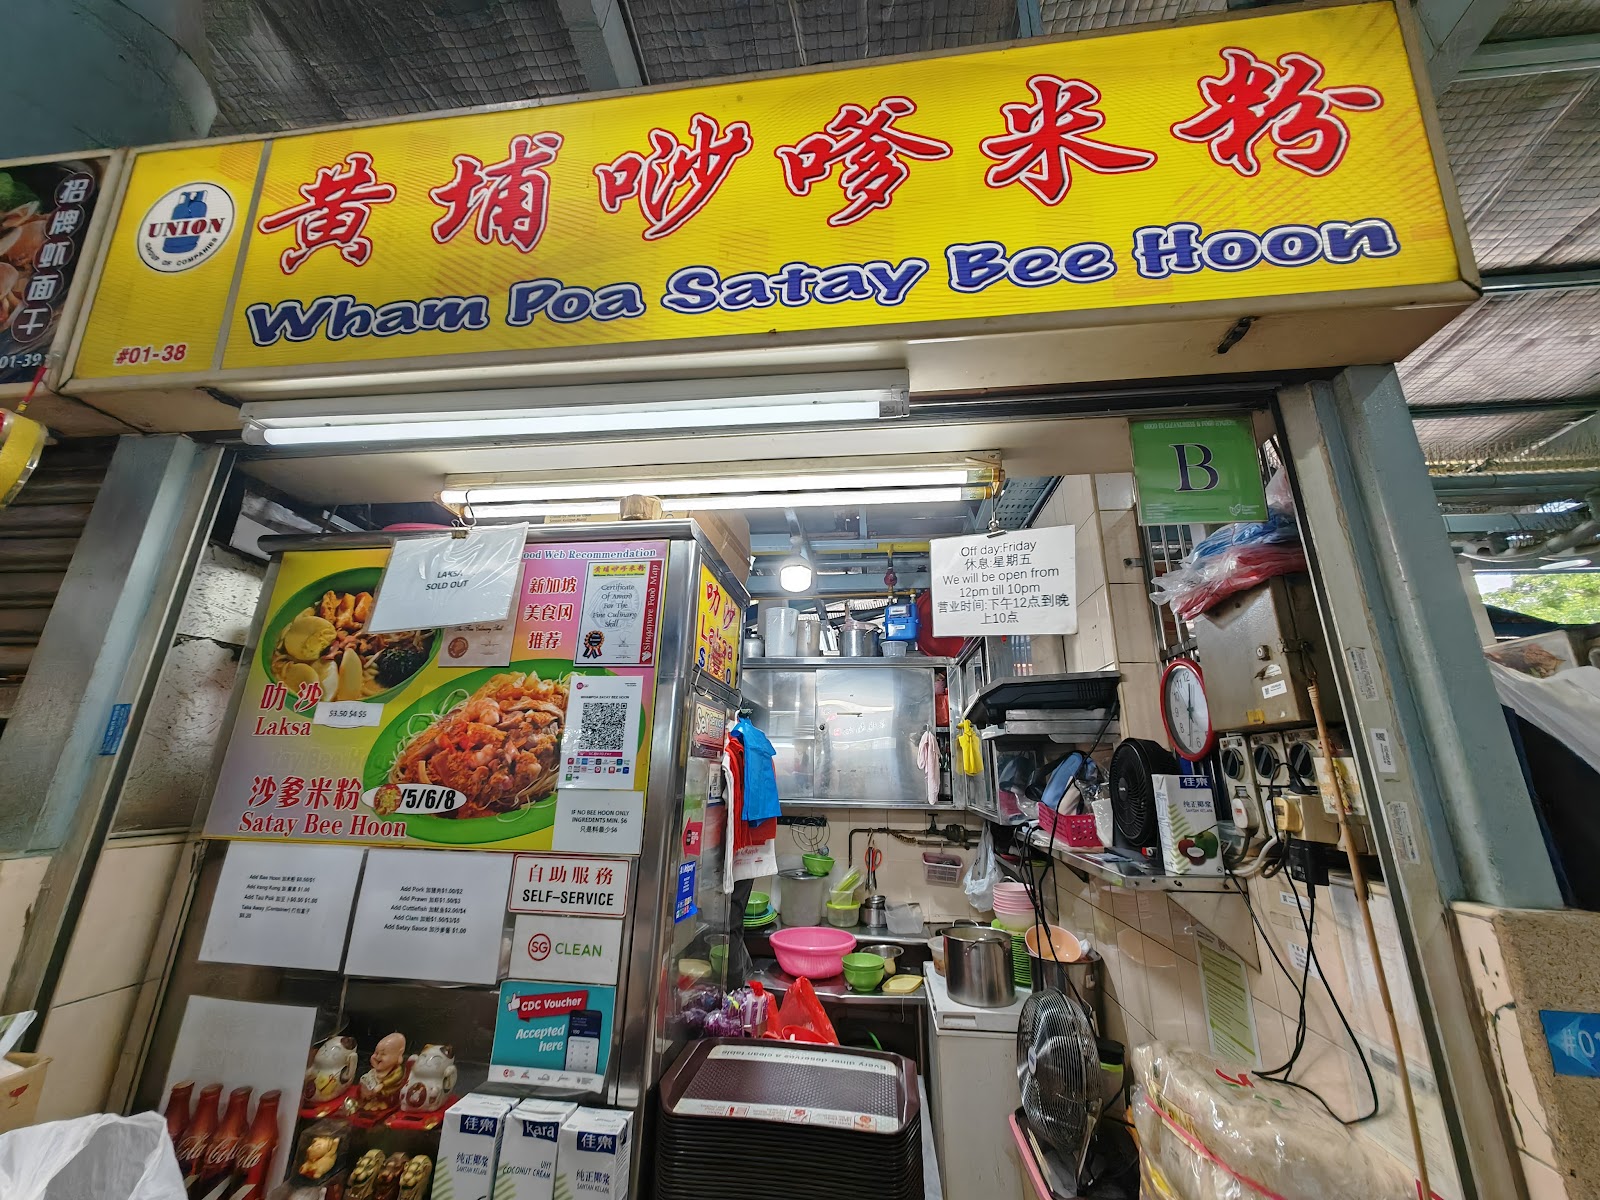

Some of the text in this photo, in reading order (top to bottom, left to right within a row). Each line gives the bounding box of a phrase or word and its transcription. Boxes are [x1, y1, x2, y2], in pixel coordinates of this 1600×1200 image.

[148, 218, 226, 238] UNION
[176, 237, 218, 266] COMPANIES
[246, 218, 1400, 346] Wham Poa Satay Bee Hoon
[115, 344, 187, 365] #01-38
[1168, 442, 1220, 493] B
[544, 550, 566, 559] Web
[568, 549, 657, 559] Recommendation
[961, 540, 1037, 557] Off day:Friday
[964, 553, 1032, 571] 休息:星期五
[425, 579, 469, 590] SOLD OUT
[943, 567, 1060, 585] We will be open from
[528, 576, 577, 595] 新加坡
[601, 582, 635, 592] Certificate
[959, 583, 1041, 599] 12pm till 10pm
[524, 603, 574, 621] 美食网
[643, 564, 660, 651] Singapore Food Map
[937, 593, 1070, 614] 营业时间:下午12点到晚
[607, 610, 637, 620] Culinary
[980, 611, 1019, 624] 上10点
[528, 630, 563, 650] 推荐
[1182, 671, 1191, 682] 12
[259, 682, 323, 712] 叻沙
[254, 716, 311, 737] Laksa
[248, 775, 363, 811] 沙爹米粉
[238, 811, 407, 838] Satay Bee Hoon
[528, 864, 614, 885] 自助服務
[522, 889, 614, 906] SELF-SERVICE
[396, 924, 411, 932] Satay
[531, 941, 602, 957] SG CLEAN
[520, 997, 582, 1011] CDC Voucher
[515, 1023, 566, 1040] Accepted
[538, 1040, 564, 1052] here
[784, 1053, 829, 1063] deserves
[831, 1058, 856, 1066] diner
[858, 1060, 887, 1071] Every
[502, 1165, 551, 1179] COCONUT CREAM
